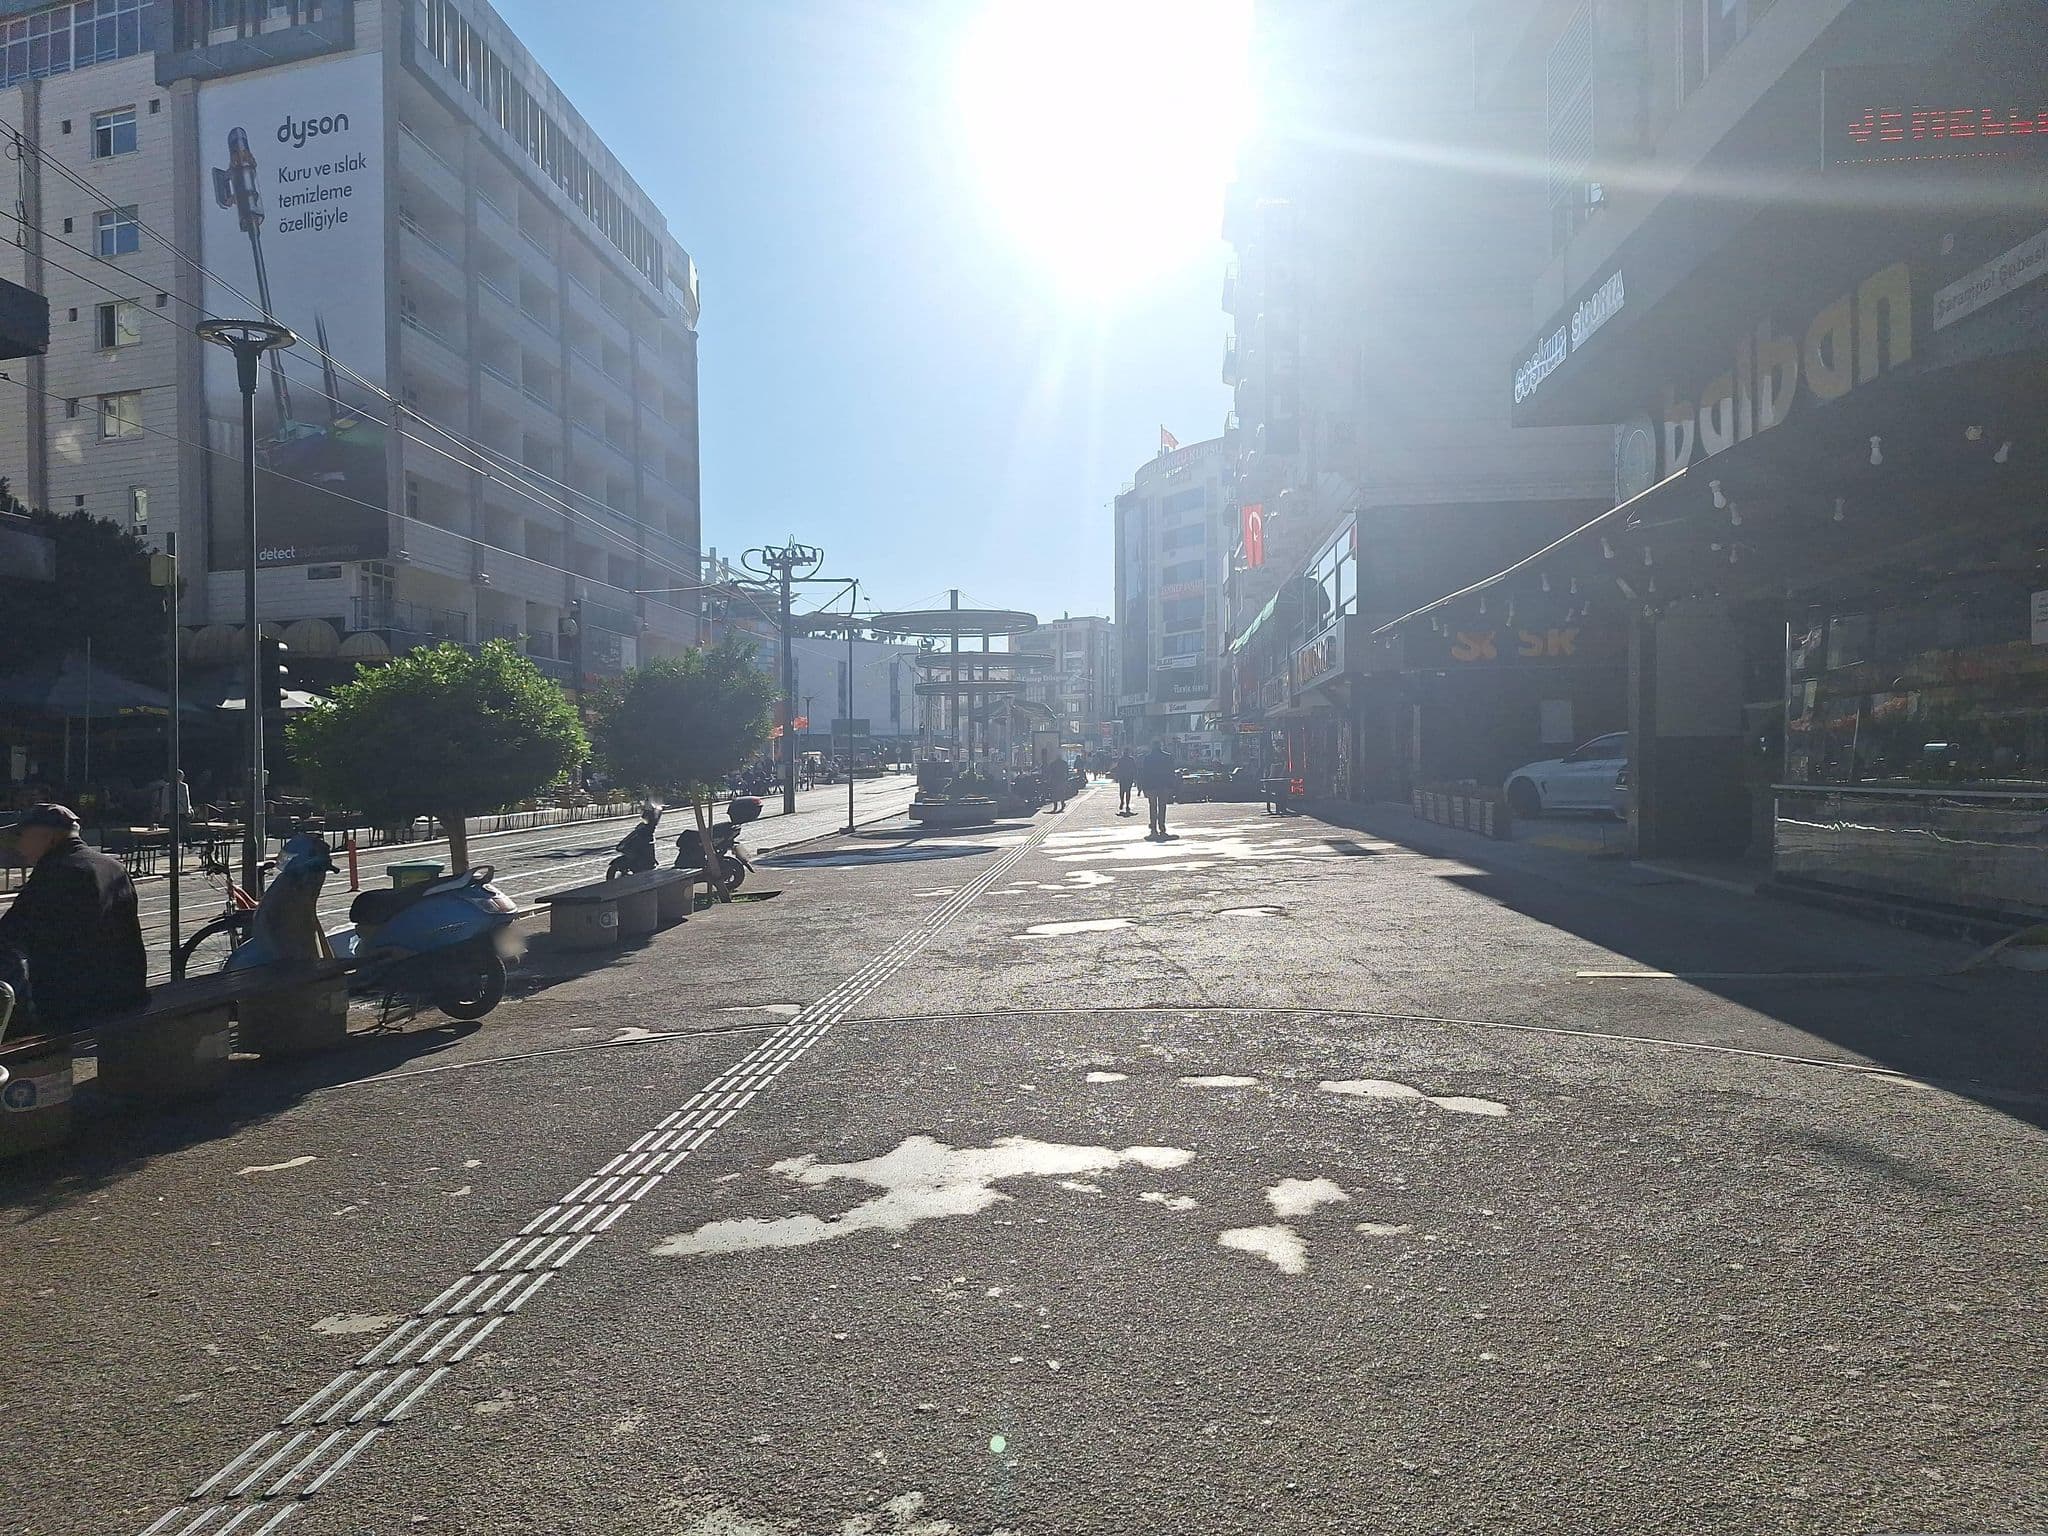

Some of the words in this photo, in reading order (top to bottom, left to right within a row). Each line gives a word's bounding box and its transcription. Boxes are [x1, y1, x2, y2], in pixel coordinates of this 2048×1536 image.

[277, 113, 349, 149] dyson
[278, 165, 312, 184] Kuru
[314, 162, 331, 176] ve
[334, 152, 368, 173] ıslak
[279, 184, 352, 208] temizleme
[279, 206, 348, 233] özelliğiyle
[1664, 262, 1912, 477] balban
[259, 545, 296, 561] detect
